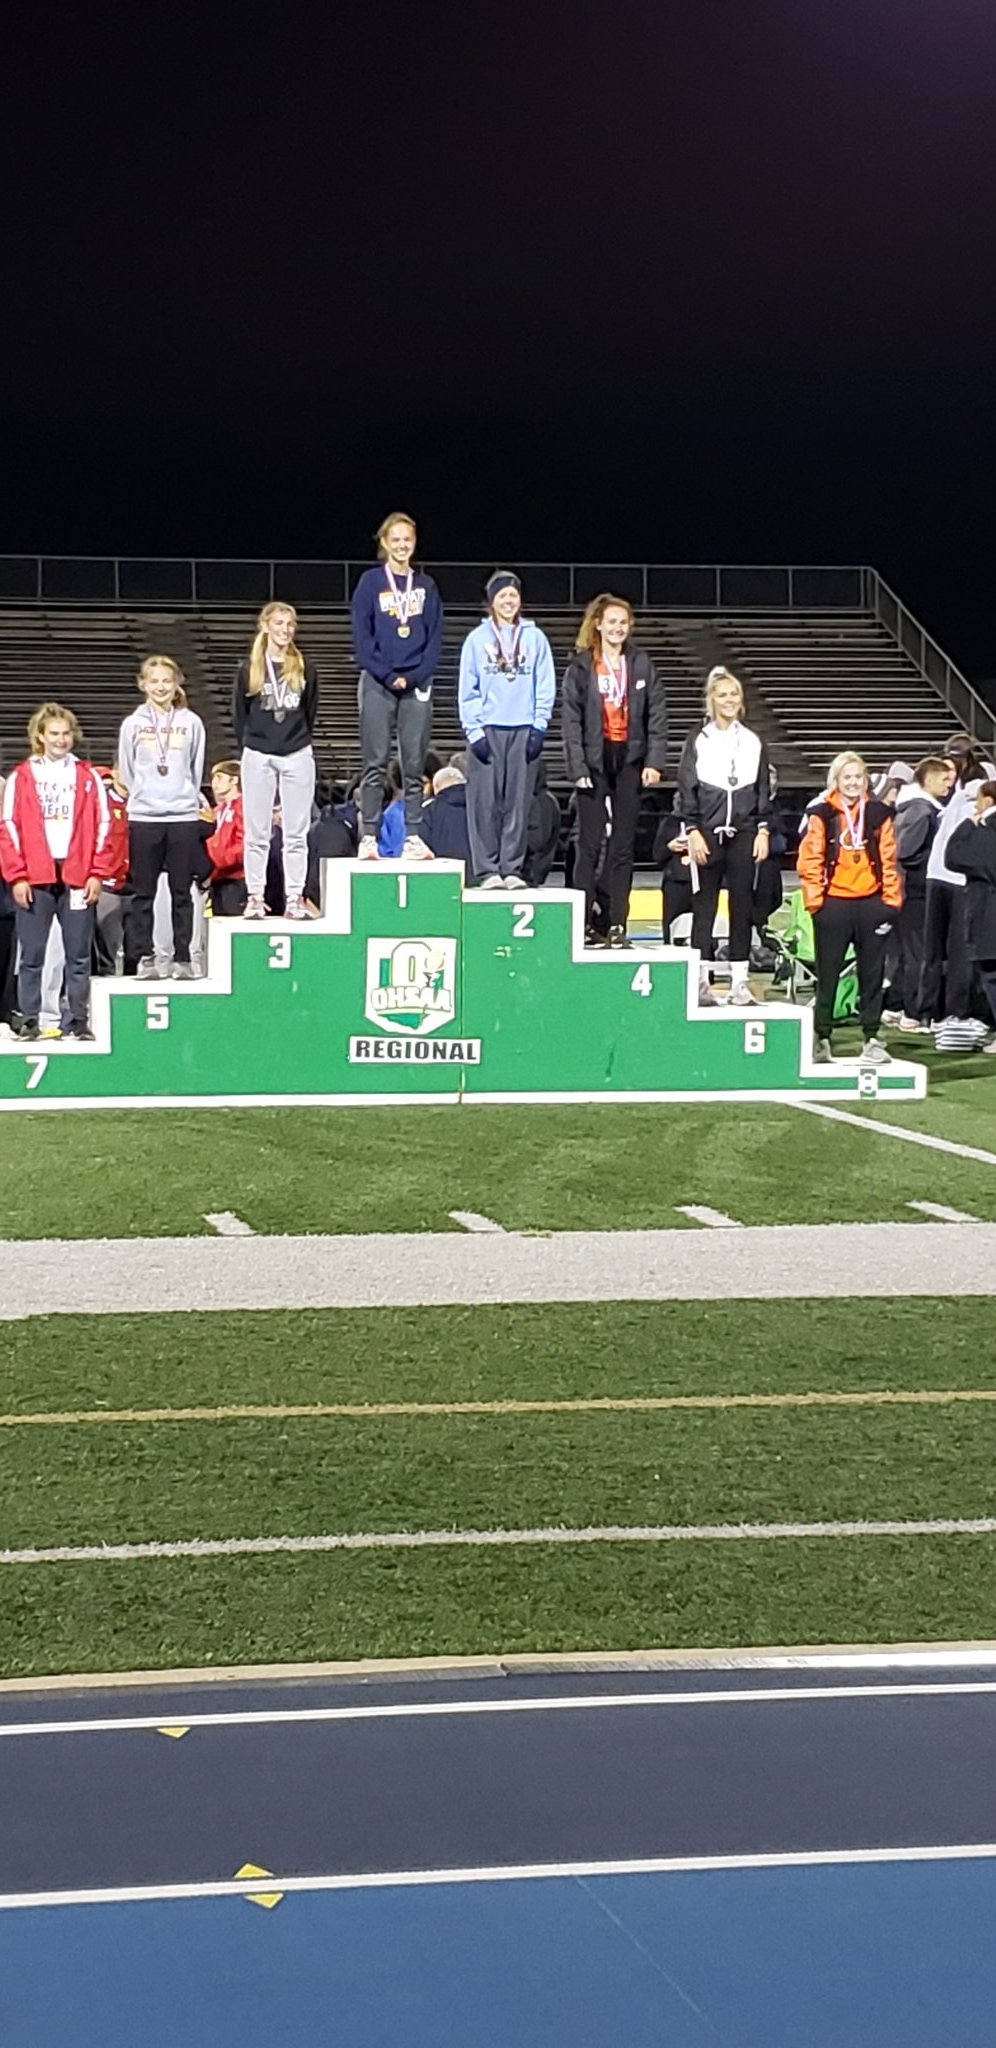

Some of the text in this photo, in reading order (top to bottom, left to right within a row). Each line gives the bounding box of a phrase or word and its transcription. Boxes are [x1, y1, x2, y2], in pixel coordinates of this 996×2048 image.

[397, 874, 407, 908] 1
[512, 903, 535, 938] 2
[268, 935, 292, 969] 3
[631, 963, 653, 997] 4
[146, 995, 169, 1030] 5
[370, 985, 452, 1013] OHSAA
[355, 1040, 477, 1060] REGIONAL
[744, 1020, 766, 1054] 6
[25, 1054, 48, 1089] 7
[858, 1070, 878, 1096] 8
